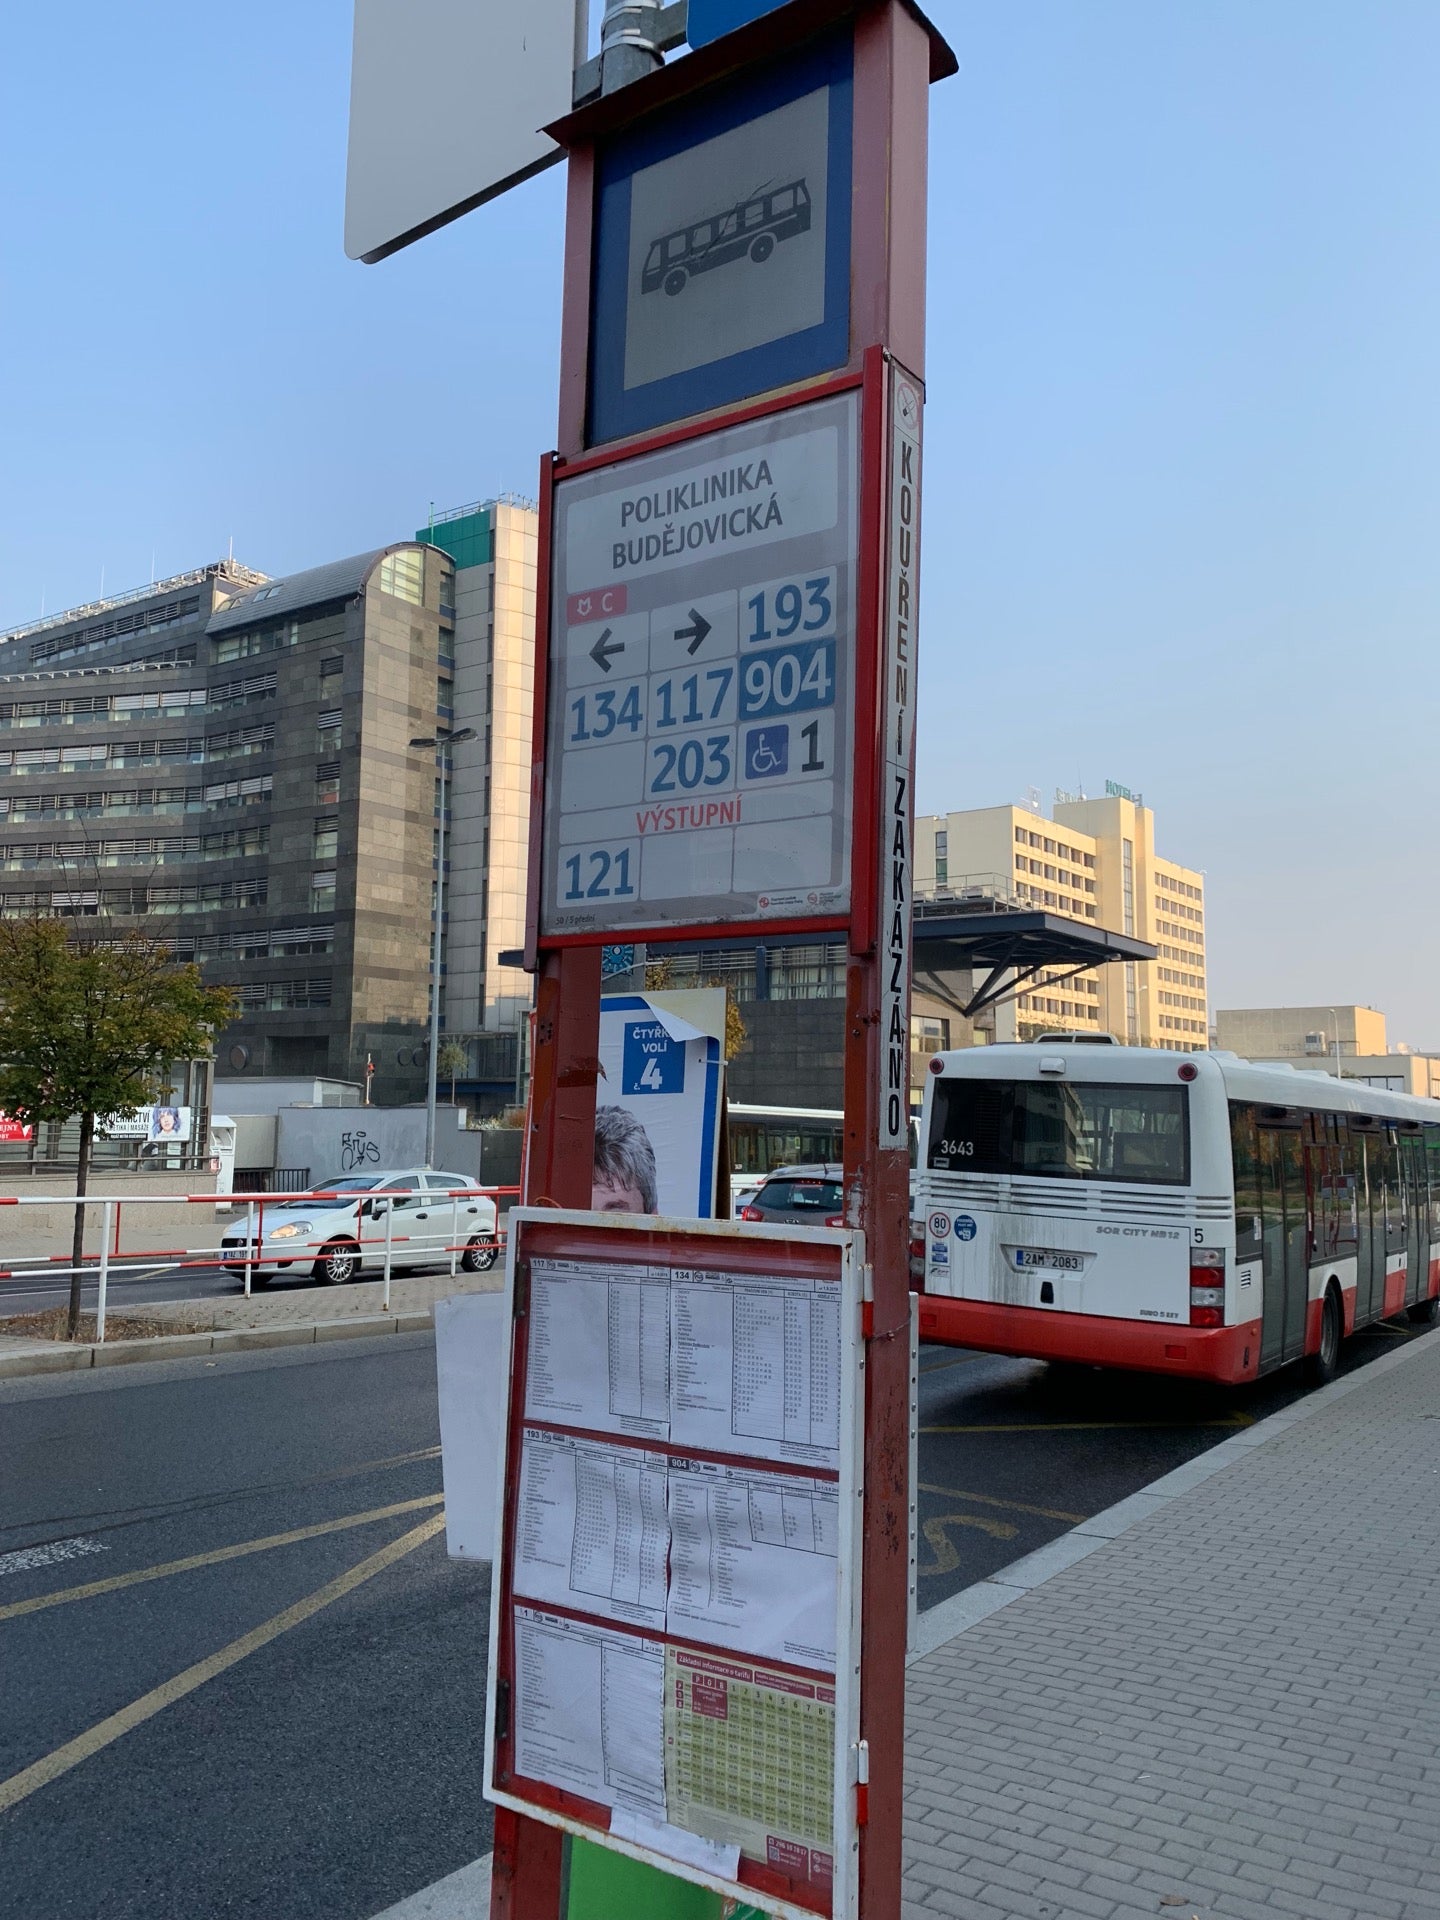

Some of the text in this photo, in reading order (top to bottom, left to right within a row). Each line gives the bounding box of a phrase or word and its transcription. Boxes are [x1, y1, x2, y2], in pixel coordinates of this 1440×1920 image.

[621, 459, 773, 527] POLIKLINIKA
[612, 492, 783, 569] BUDĚJOVICKÁ
[602, 592, 614, 613] C
[747, 576, 832, 643] 193
[744, 647, 831, 712] 904
[656, 667, 733, 728] 117
[571, 685, 643, 742] 134
[801, 720, 825, 772] 1
[651, 734, 731, 793] 203
[886, 441, 914, 1136] KOUŘENÍ ZAKÁZÁNO
[636, 795, 742, 834] VÝSTUPNÍ
[565, 848, 634, 900] 121
[632, 1026, 671, 1040] ČTYŘK
[641, 1040, 668, 1053] VOLÍ
[640, 1057, 663, 1090] 4
[940, 1139, 974, 1156] 3643
[934, 1217, 947, 1229] 80
[1095, 1226, 1120, 1235] SOR
[1122, 1228, 1149, 1237] CITY
[1194, 1228, 1204, 1244] 5
[1025, 1254, 1079, 1270] 2AM 2083
[675, 1271, 690, 1280] 134
[526, 1430, 540, 1439] 193
[671, 1458, 688, 1469] 904
[523, 1609, 529, 1618] 1
[701, 1661, 730, 1675] informace
[734, 1669, 751, 1680] tarifu
